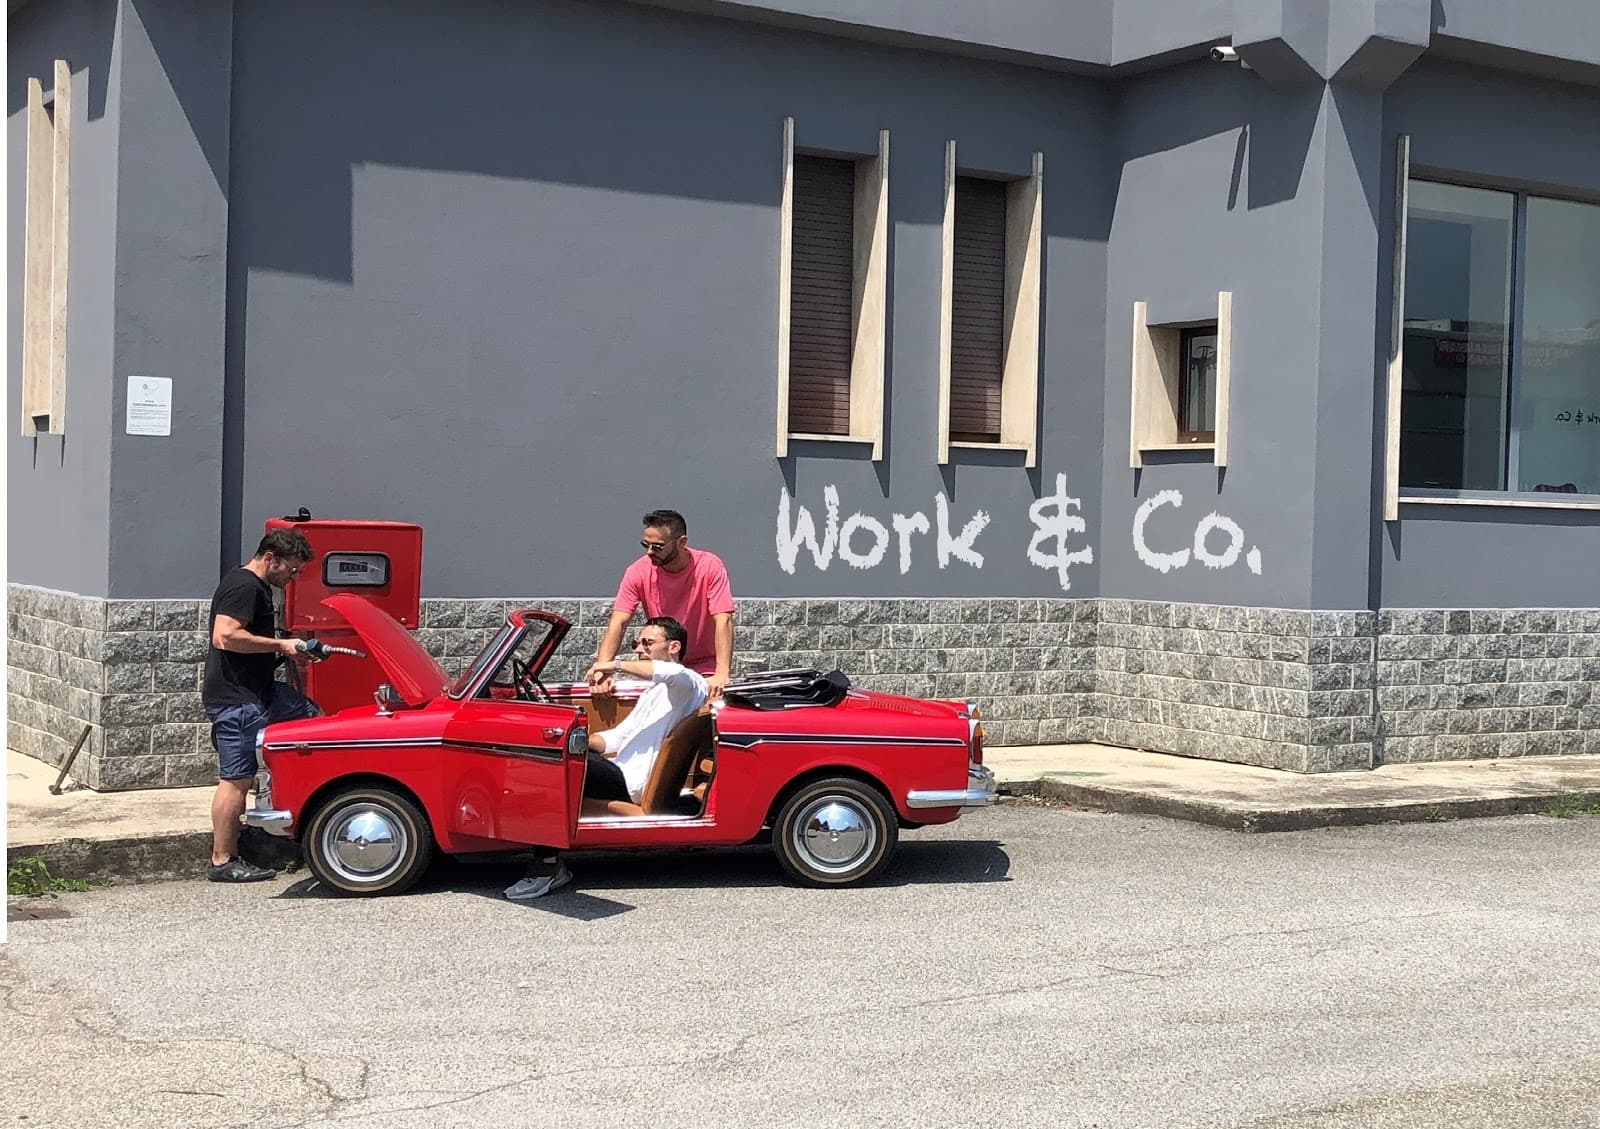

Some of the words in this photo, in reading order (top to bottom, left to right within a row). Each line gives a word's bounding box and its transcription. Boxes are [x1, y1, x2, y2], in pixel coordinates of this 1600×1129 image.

[775, 484, 991, 575] Work
[1026, 472, 1094, 591] &
[1132, 489, 1262, 576] Co.
